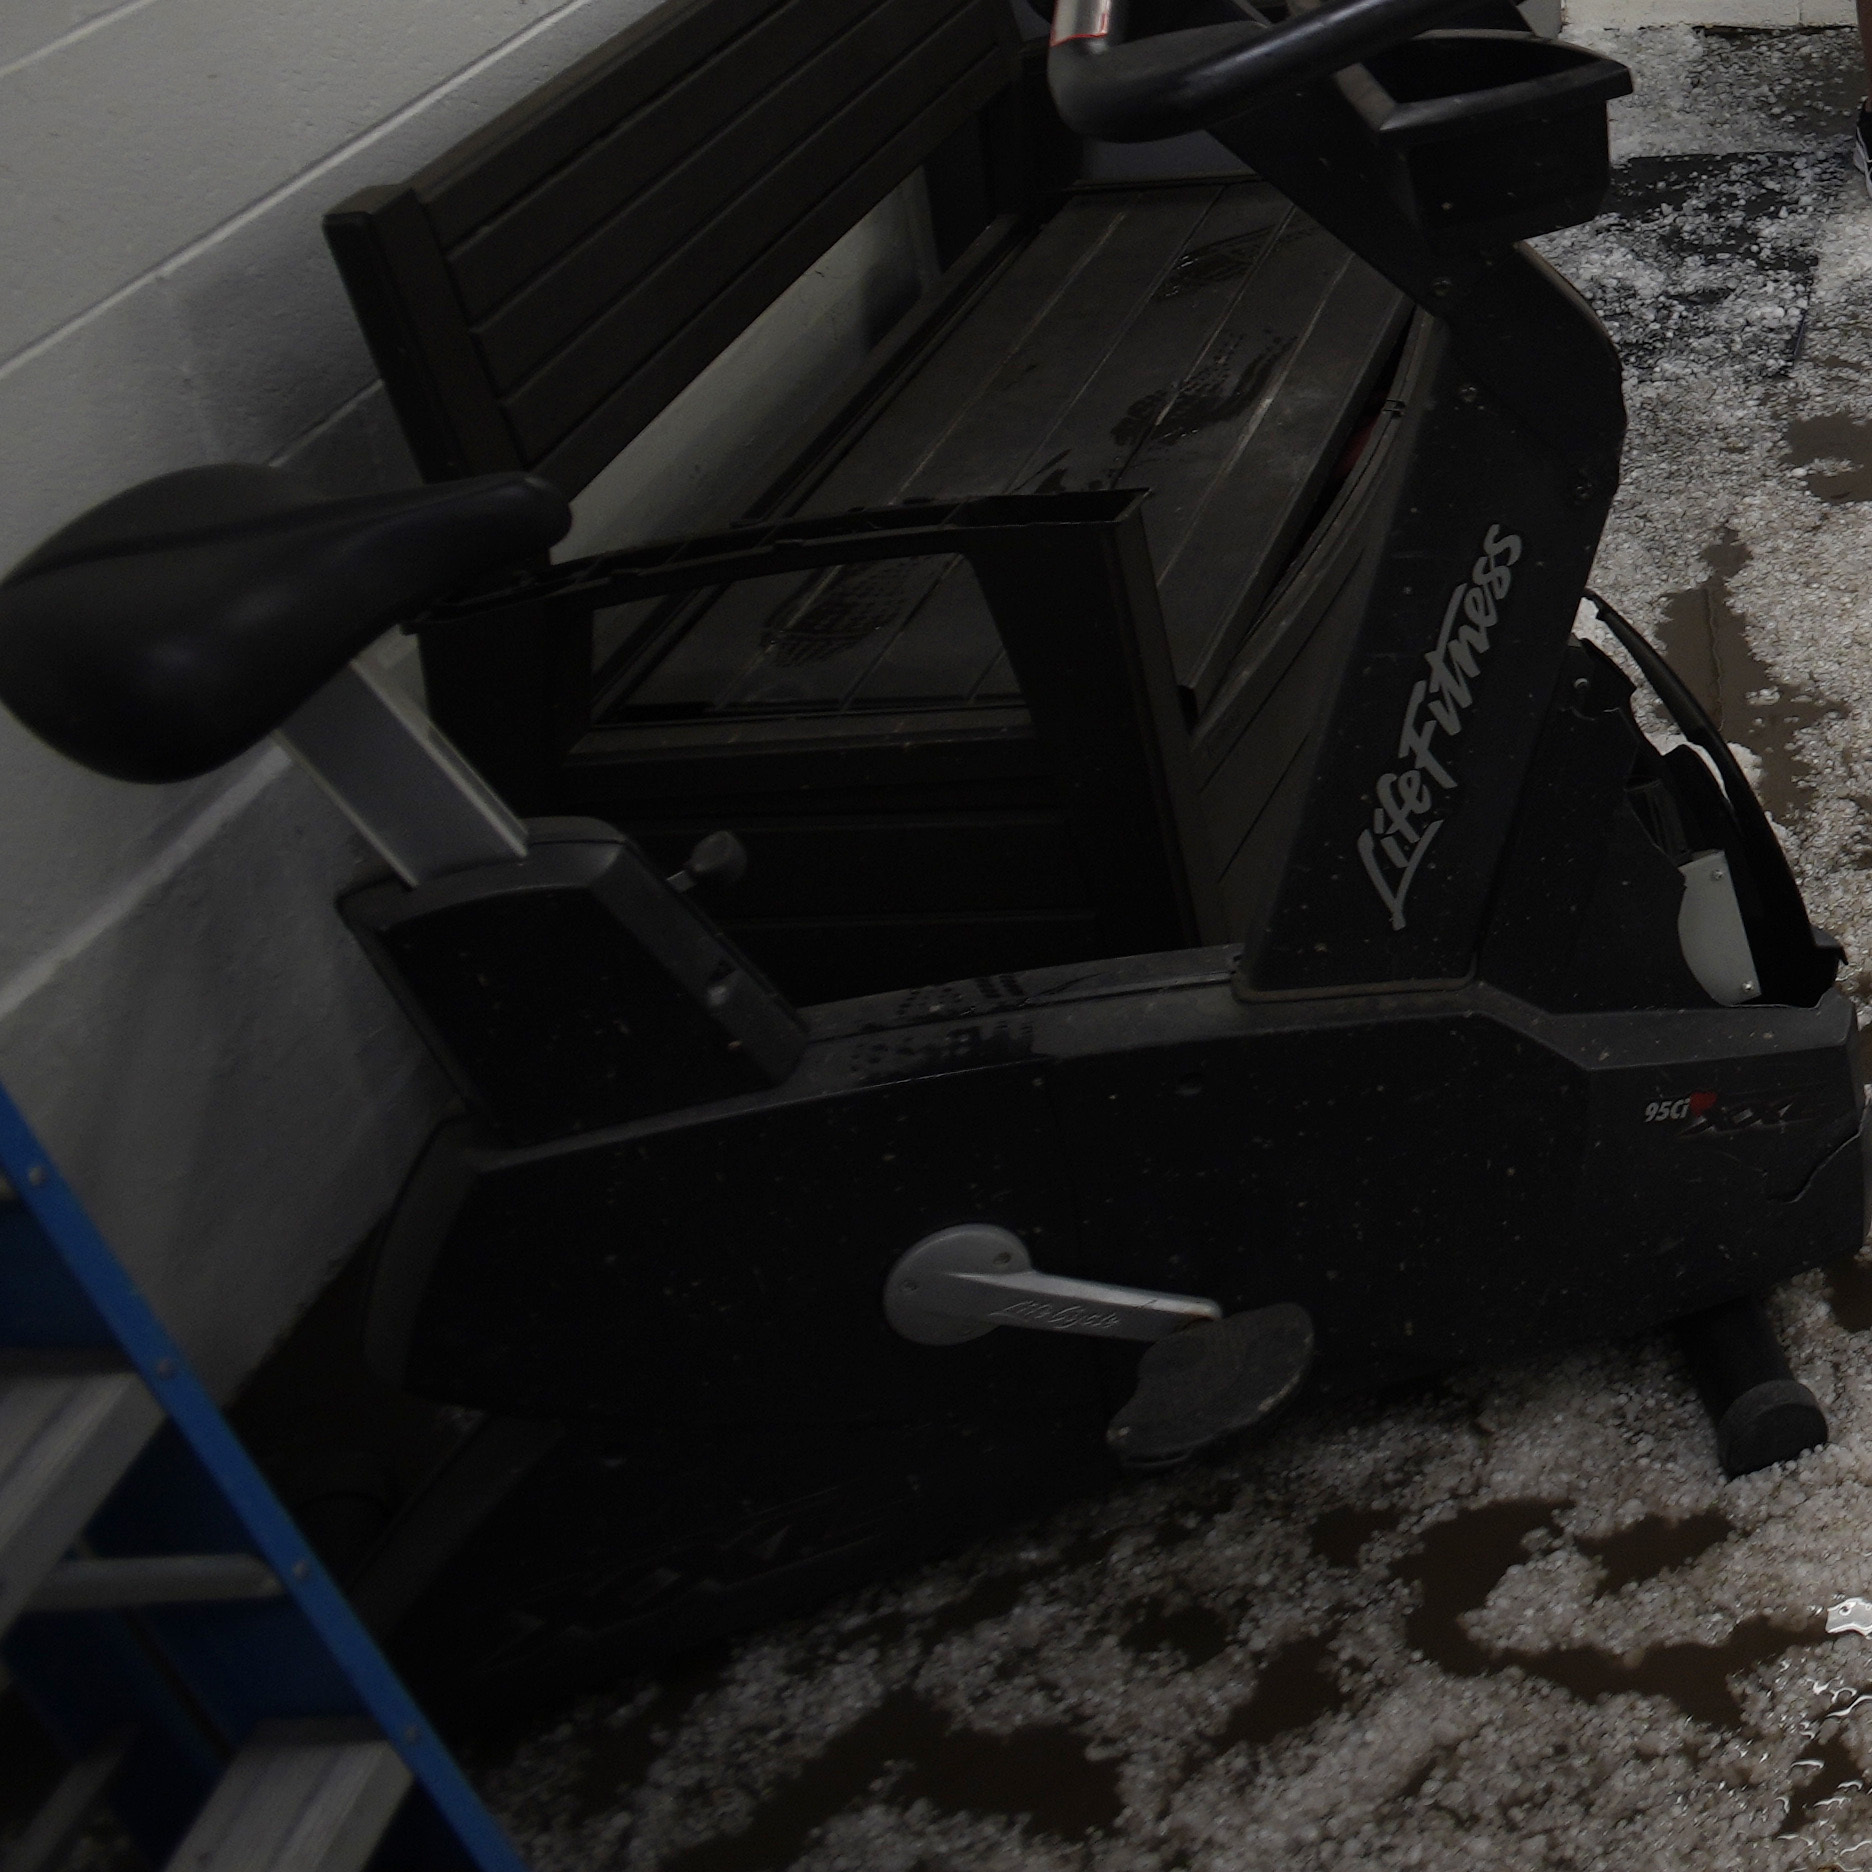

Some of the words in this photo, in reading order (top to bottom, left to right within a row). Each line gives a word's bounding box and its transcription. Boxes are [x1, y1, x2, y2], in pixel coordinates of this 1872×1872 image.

[1398, 523, 1522, 788] Fitness
[1357, 768, 1445, 931] Life
[1644, 1096, 1691, 1123] 95Ci
